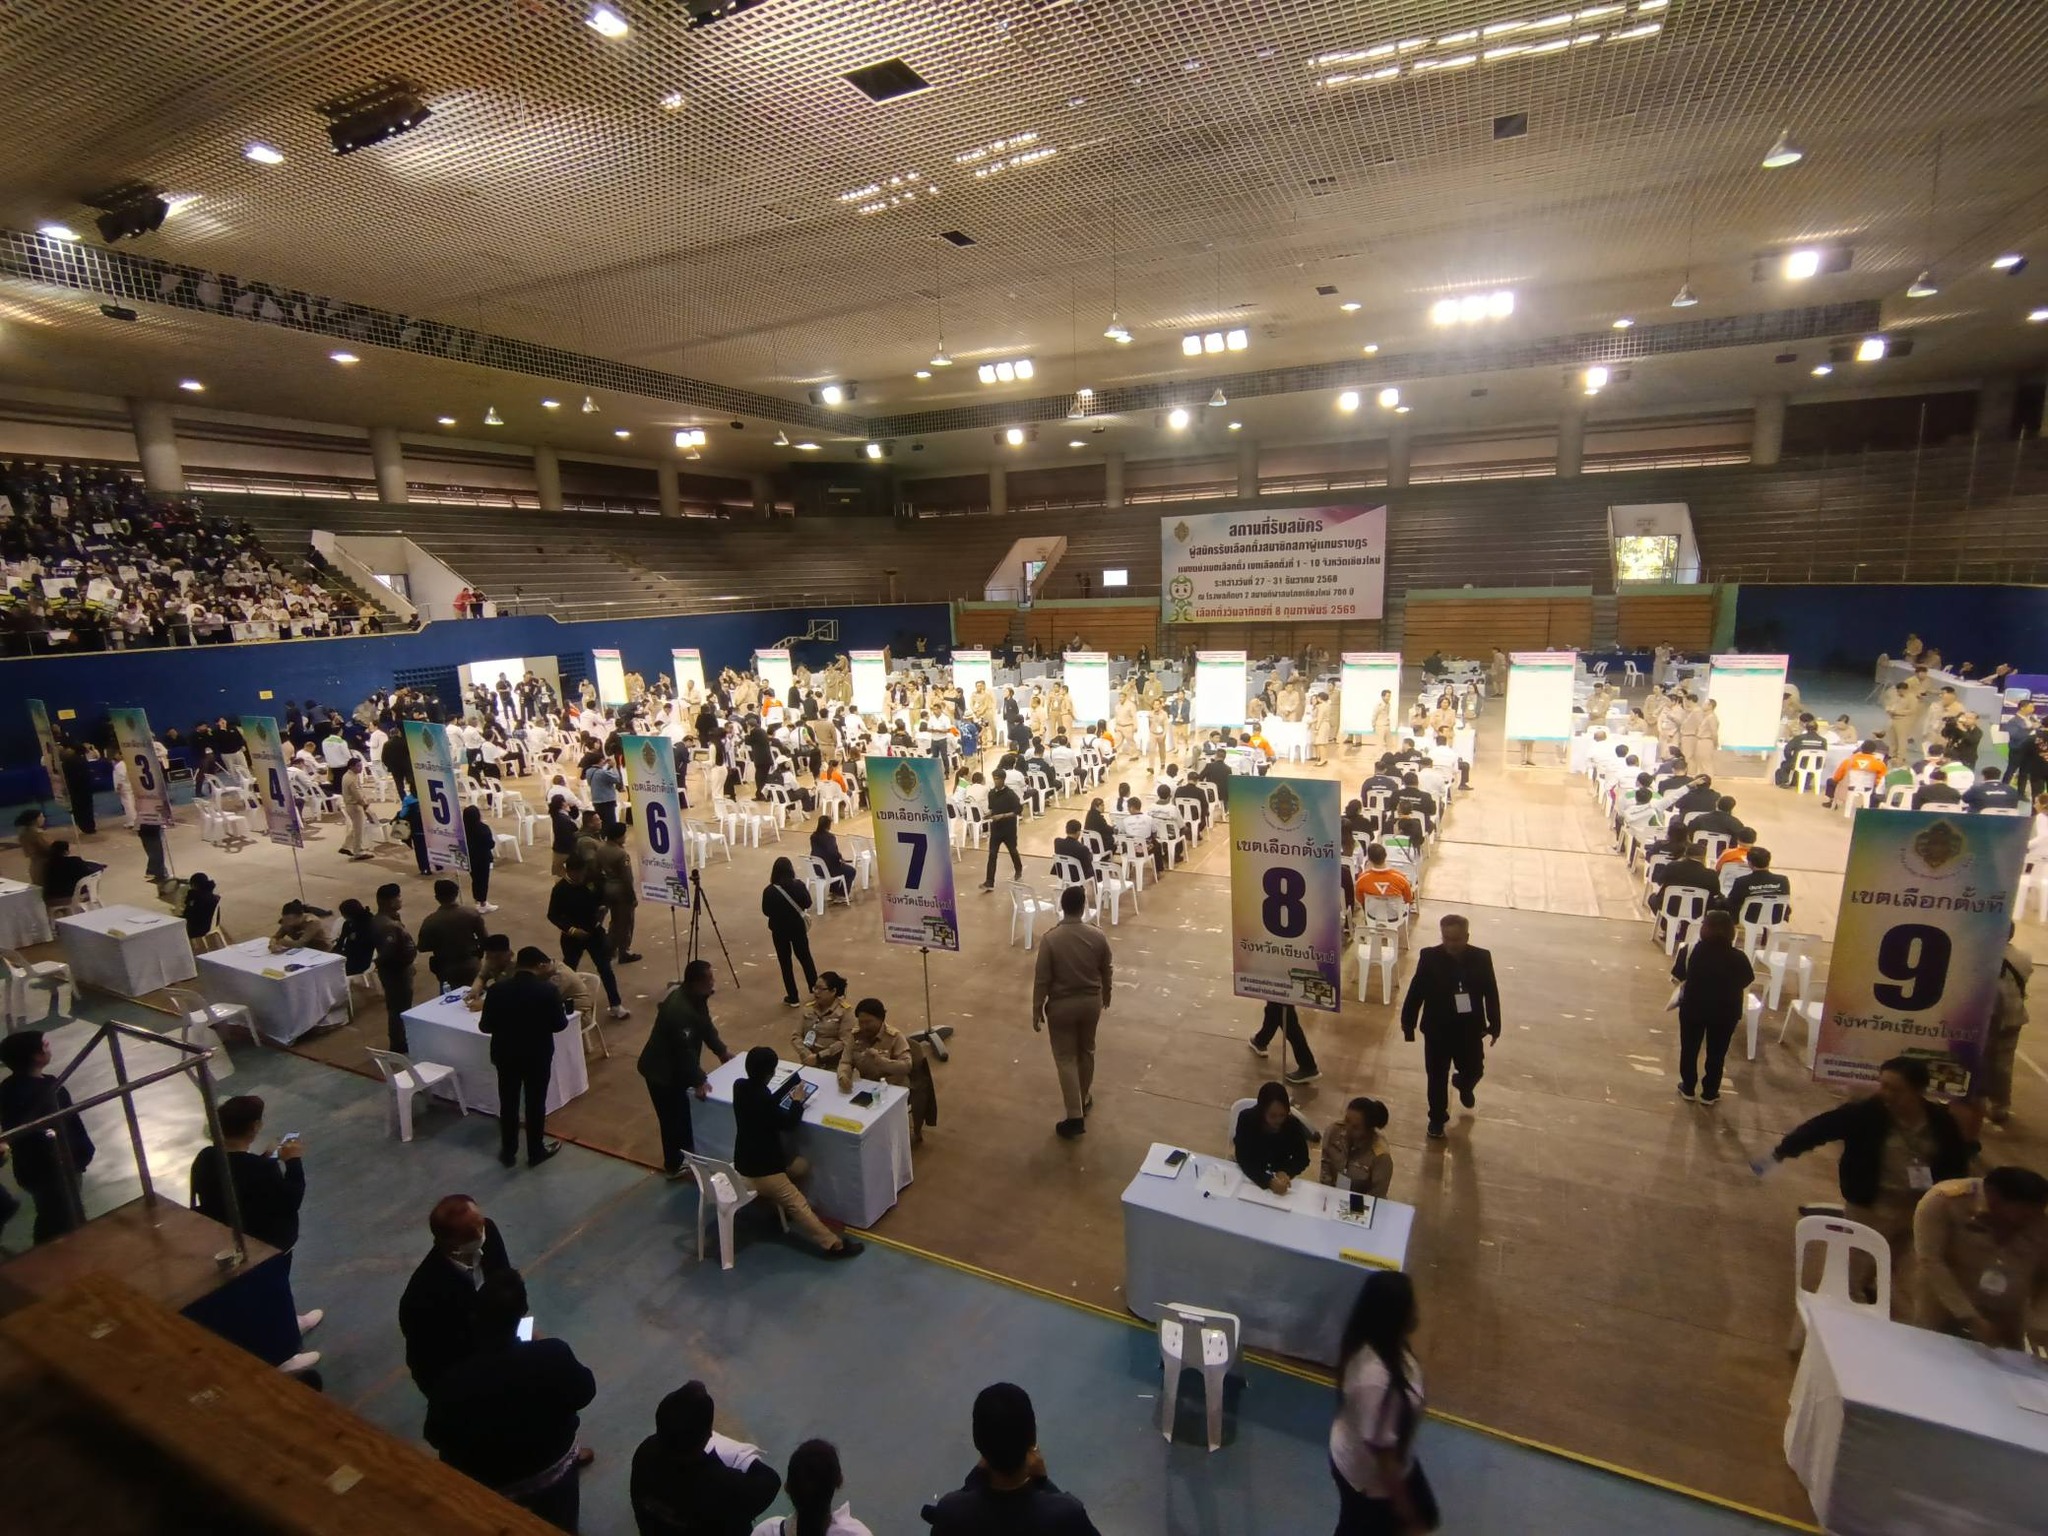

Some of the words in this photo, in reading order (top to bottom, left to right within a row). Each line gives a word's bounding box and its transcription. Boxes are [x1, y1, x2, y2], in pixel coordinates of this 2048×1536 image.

[1228, 515, 1323, 537] สถานที่รับสมัคร
[1310, 559, 1321, 567] 10
[1255, 577, 1265, 586] 27
[1273, 576, 1283, 585] 31
[1285, 575, 1315, 585] ธันวาคม
[1316, 574, 1338, 584] 2568
[1275, 606, 1281, 615] 8
[1330, 604, 1356, 615] 2569
[134, 754, 155, 791] 3
[268, 768, 285, 808] 4
[427, 779, 451, 825] 5
[645, 801, 670, 855] 6
[876, 805, 944, 824] เขตเลือกตั้งที่
[897, 832, 928, 889] 7
[1236, 837, 1334, 860] เขตเลือกตั้งที่
[1262, 867, 1307, 938] 8
[1851, 886, 2007, 914] เขตเลือกตั้งที่
[1240, 938, 1335, 965] จังหวัดเชียงใหม่
[1873, 923, 1952, 1012] 9
